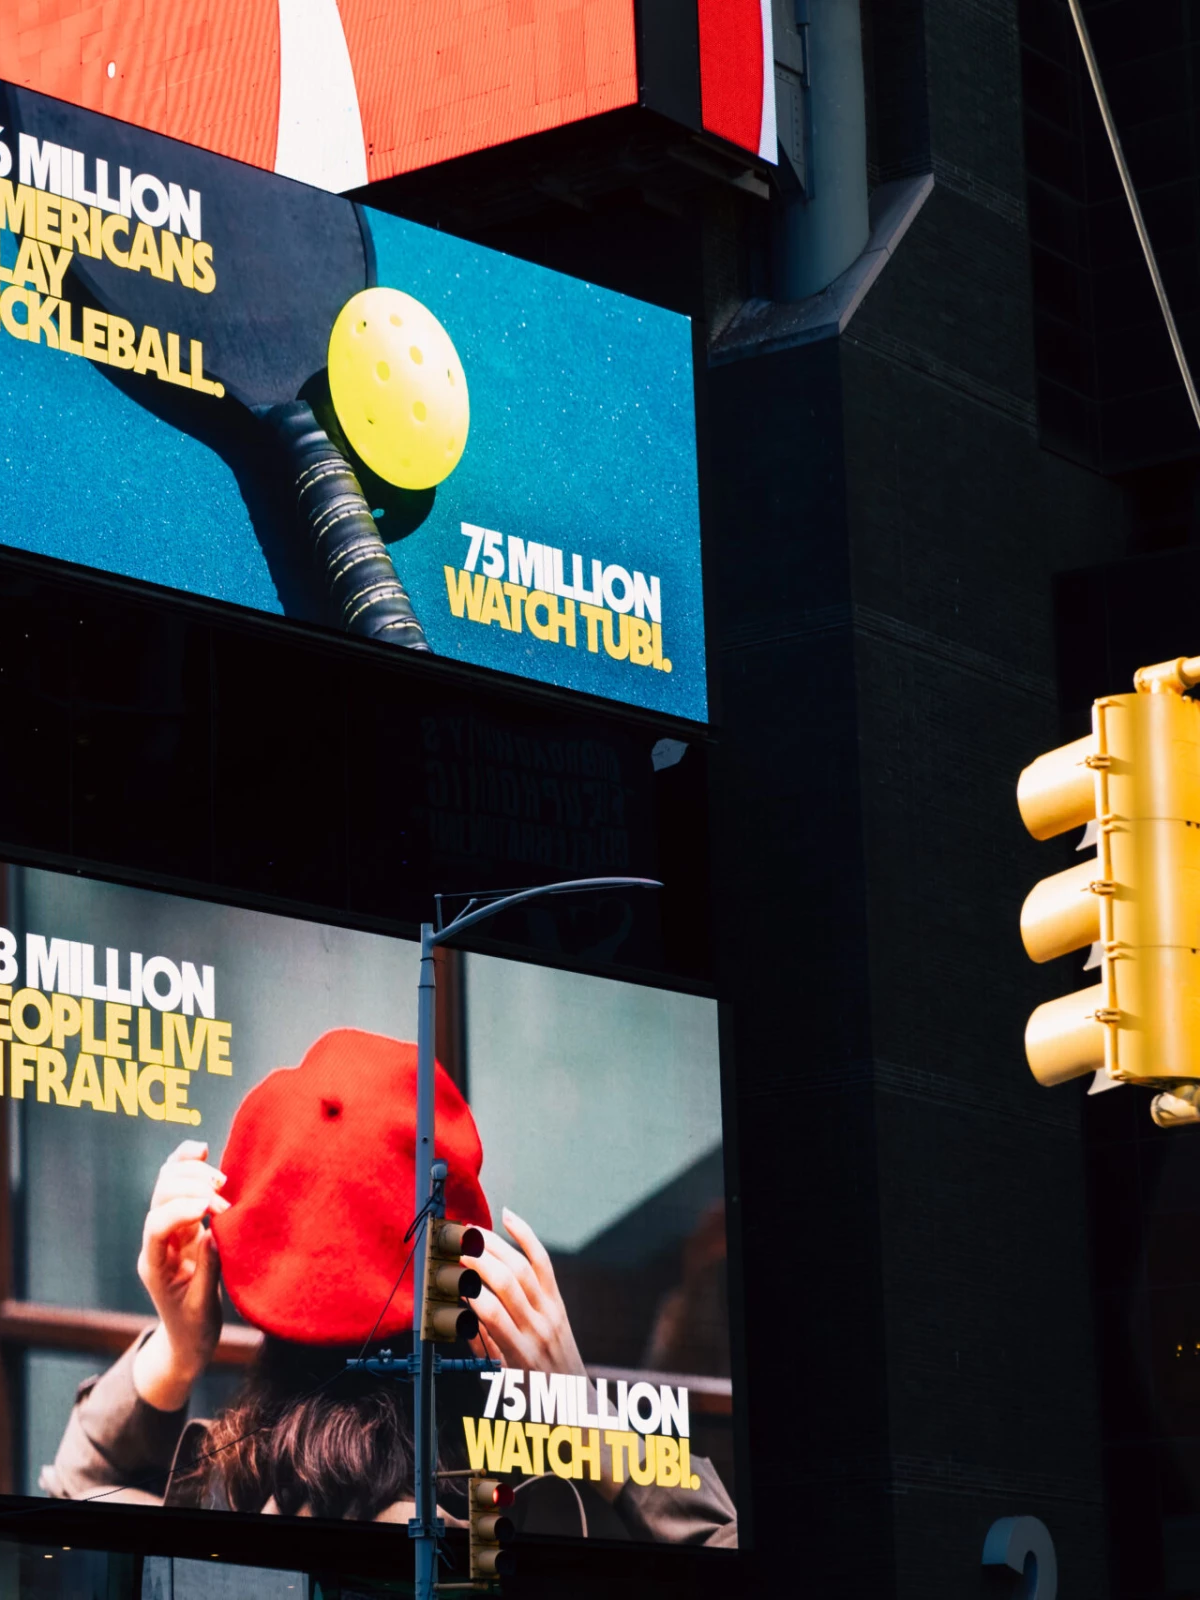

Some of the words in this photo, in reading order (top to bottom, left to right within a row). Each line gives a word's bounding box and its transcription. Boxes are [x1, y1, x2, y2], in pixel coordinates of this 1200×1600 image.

[19, 132, 201, 240] MILLION
[461, 521, 505, 579] 75
[508, 535, 661, 623] MILLION
[444, 565, 576, 647] WATCH
[580, 603, 672, 673] TUBI.
[26, 932, 215, 1018] MILLION
[11, 1042, 201, 1126] FRANCE.
[138, 1008, 232, 1076] LIVE
[480, 1368, 526, 1421] 75
[529, 1370, 690, 1438] MILLION
[463, 1416, 600, 1481] WATCH
[605, 1430, 700, 1490] TUBI.
